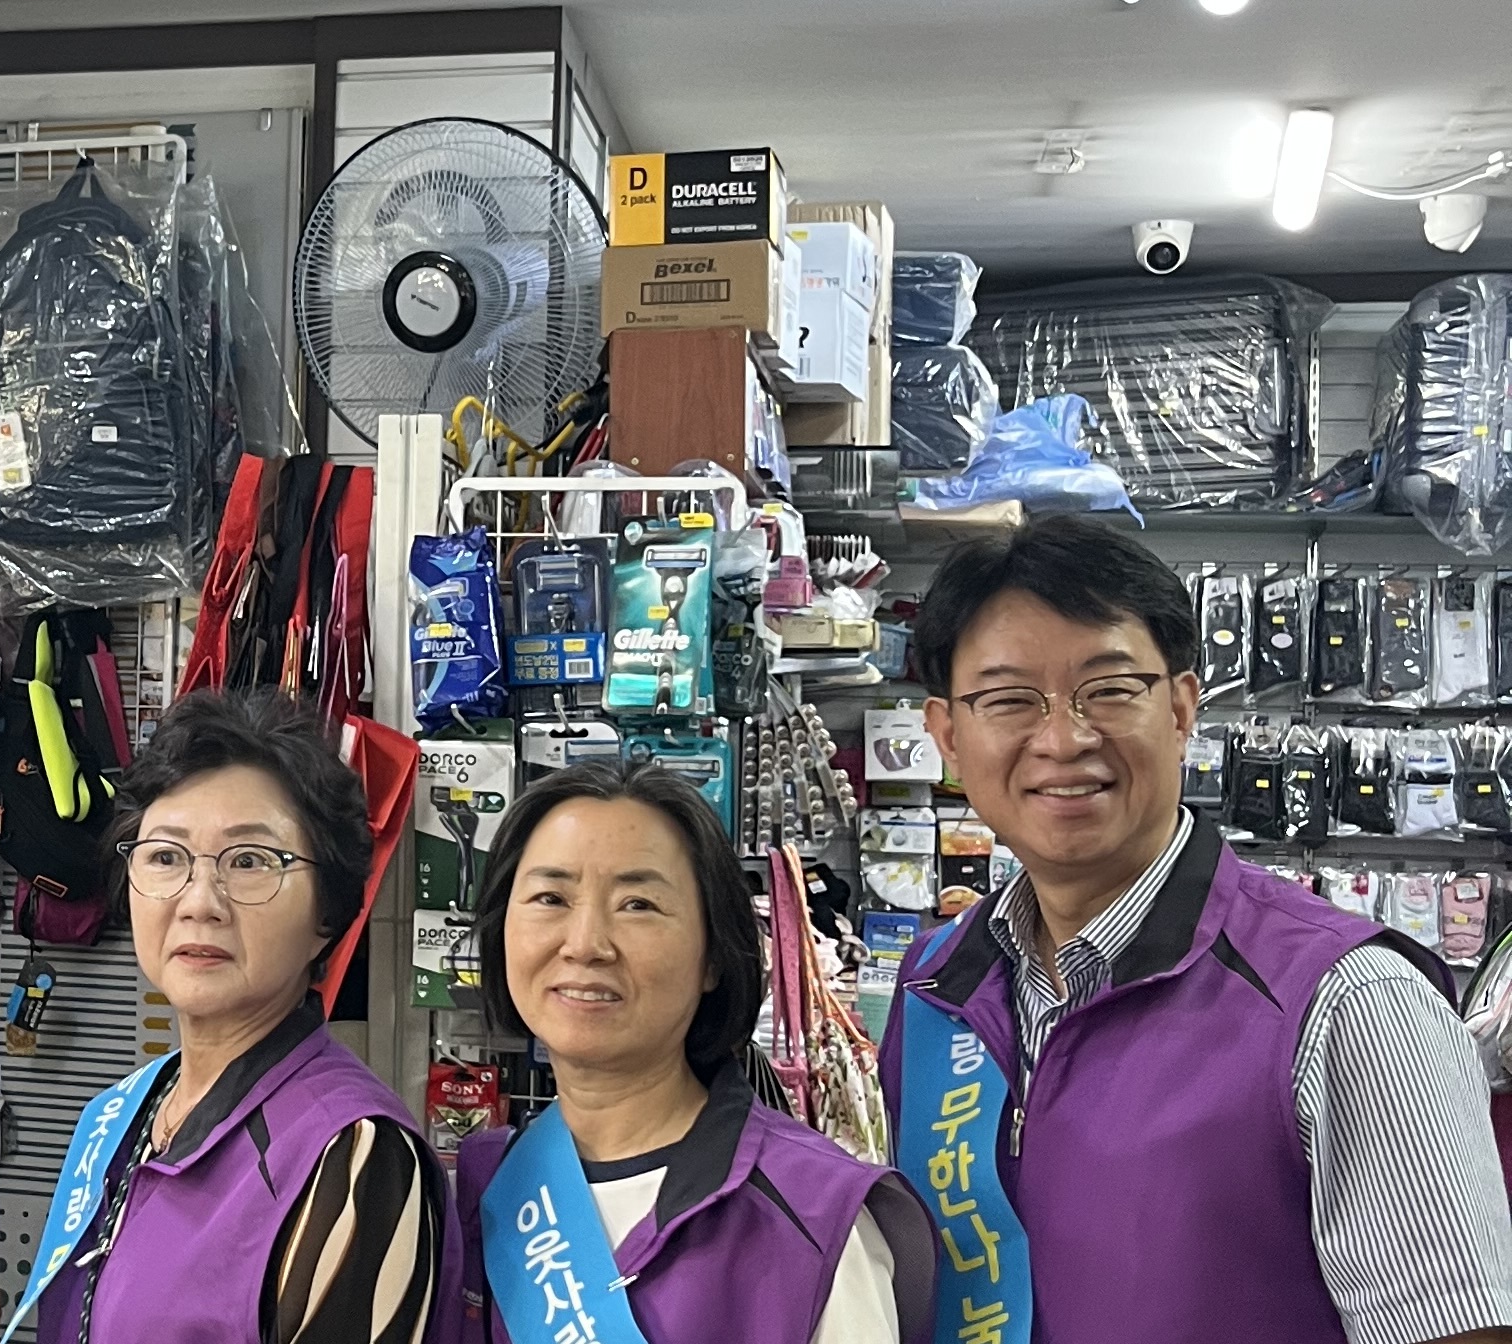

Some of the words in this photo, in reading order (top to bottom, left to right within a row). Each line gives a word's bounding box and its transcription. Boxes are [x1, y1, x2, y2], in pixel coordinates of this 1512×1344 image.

[629, 167, 648, 191] D
[671, 181, 757, 199] DURACELL
[620, 194, 627, 206] 2
[630, 192, 657, 207] pack
[671, 197, 714, 208] ALKALINE
[717, 196, 757, 207] BATTERY
[654, 258, 715, 279] Bexel
[421, 640, 454, 653] Blue
[613, 628, 691, 651] Gillette
[418, 753, 477, 766] DORCO
[418, 765, 457, 775] PACE
[456, 766, 469, 783] 6
[418, 927, 468, 940] DORCO
[417, 938, 451, 947] PACE
[416, 974, 430, 985] 16
[441, 1081, 486, 1096] SONY
